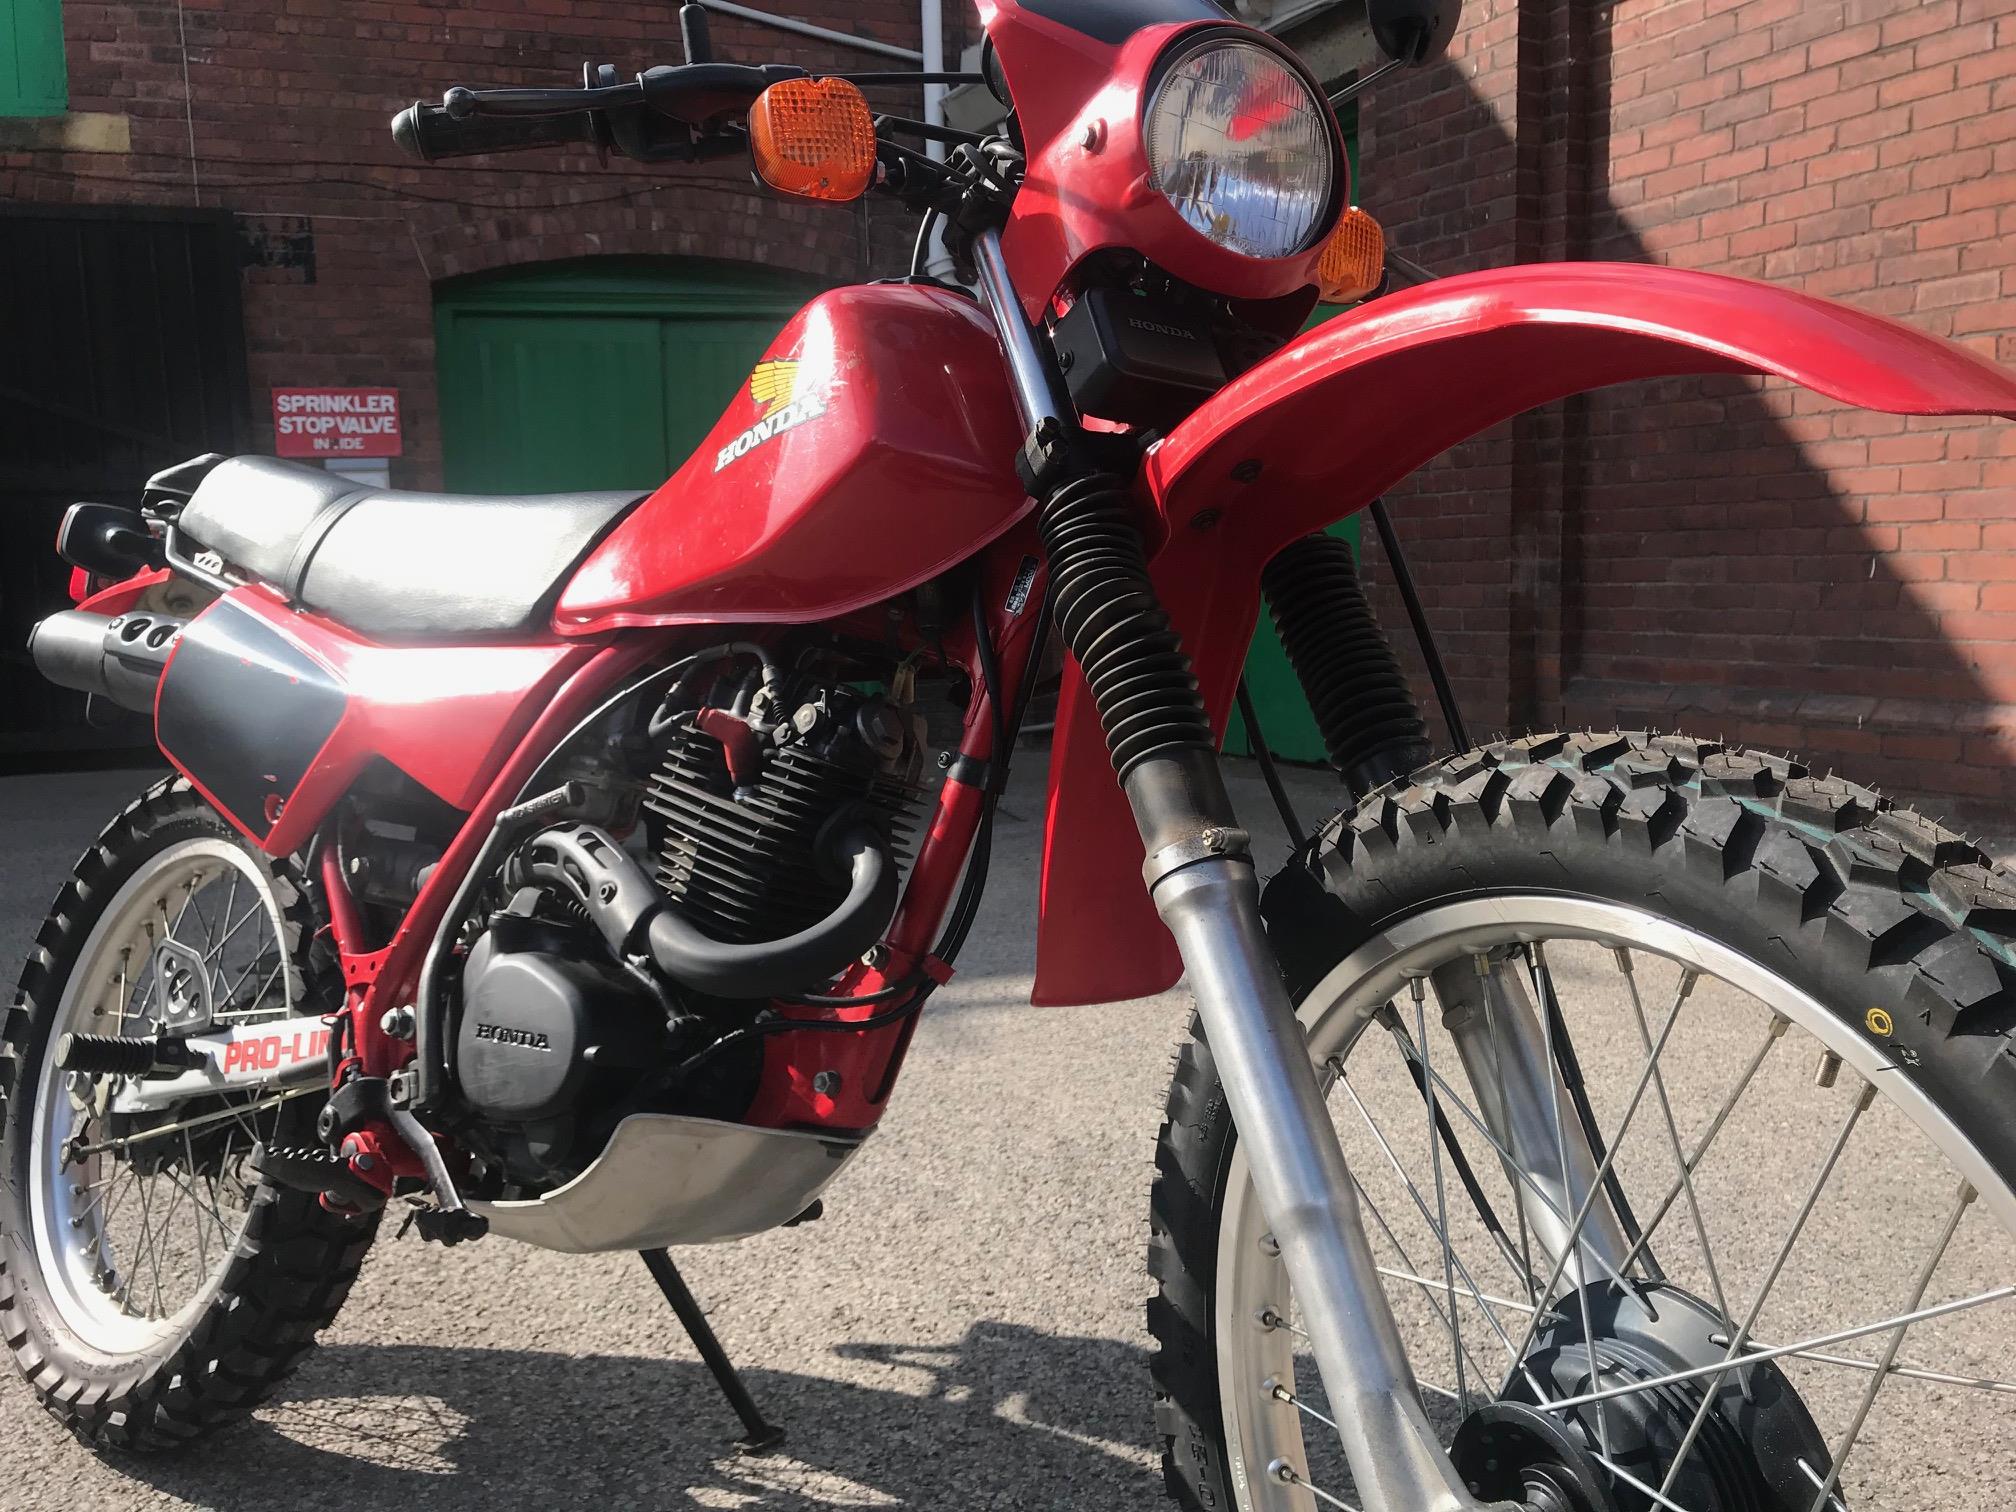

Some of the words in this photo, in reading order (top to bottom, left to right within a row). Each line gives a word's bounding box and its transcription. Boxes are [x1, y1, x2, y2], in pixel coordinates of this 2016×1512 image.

[1128, 316, 1197, 341] HONDA
[277, 394, 395, 413] SPRINKLER
[313, 437, 365, 450] INIDE
[713, 392, 828, 474] HONDA
[476, 1023, 551, 1052] HONDA
